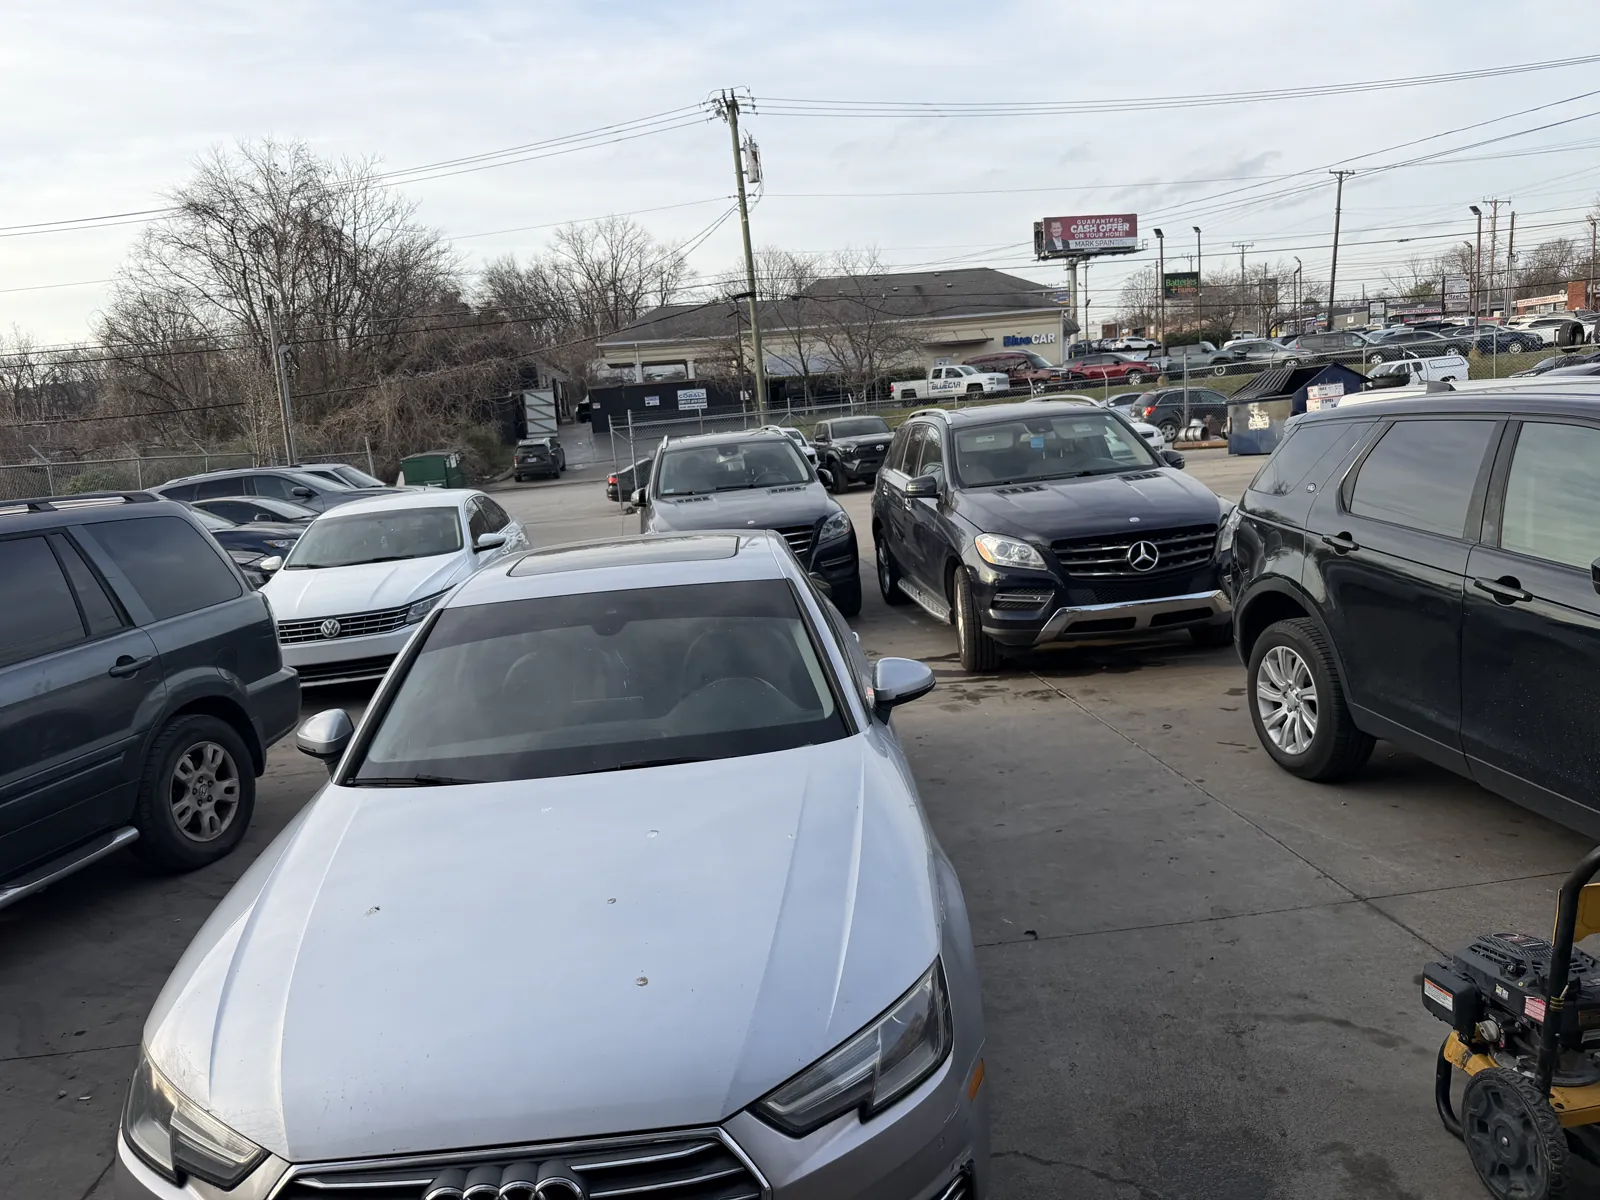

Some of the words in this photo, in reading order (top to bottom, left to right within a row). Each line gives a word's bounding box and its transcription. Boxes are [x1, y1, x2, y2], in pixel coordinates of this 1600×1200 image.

[1070, 224, 1097, 233] CASH
[1099, 222, 1129, 232] OFFER
[1074, 240, 1095, 248] MARK
[1095, 239, 1115, 247] SPAIN
[1166, 279, 1197, 287] Batteries
[1003, 333, 1056, 347] BlueCAR
